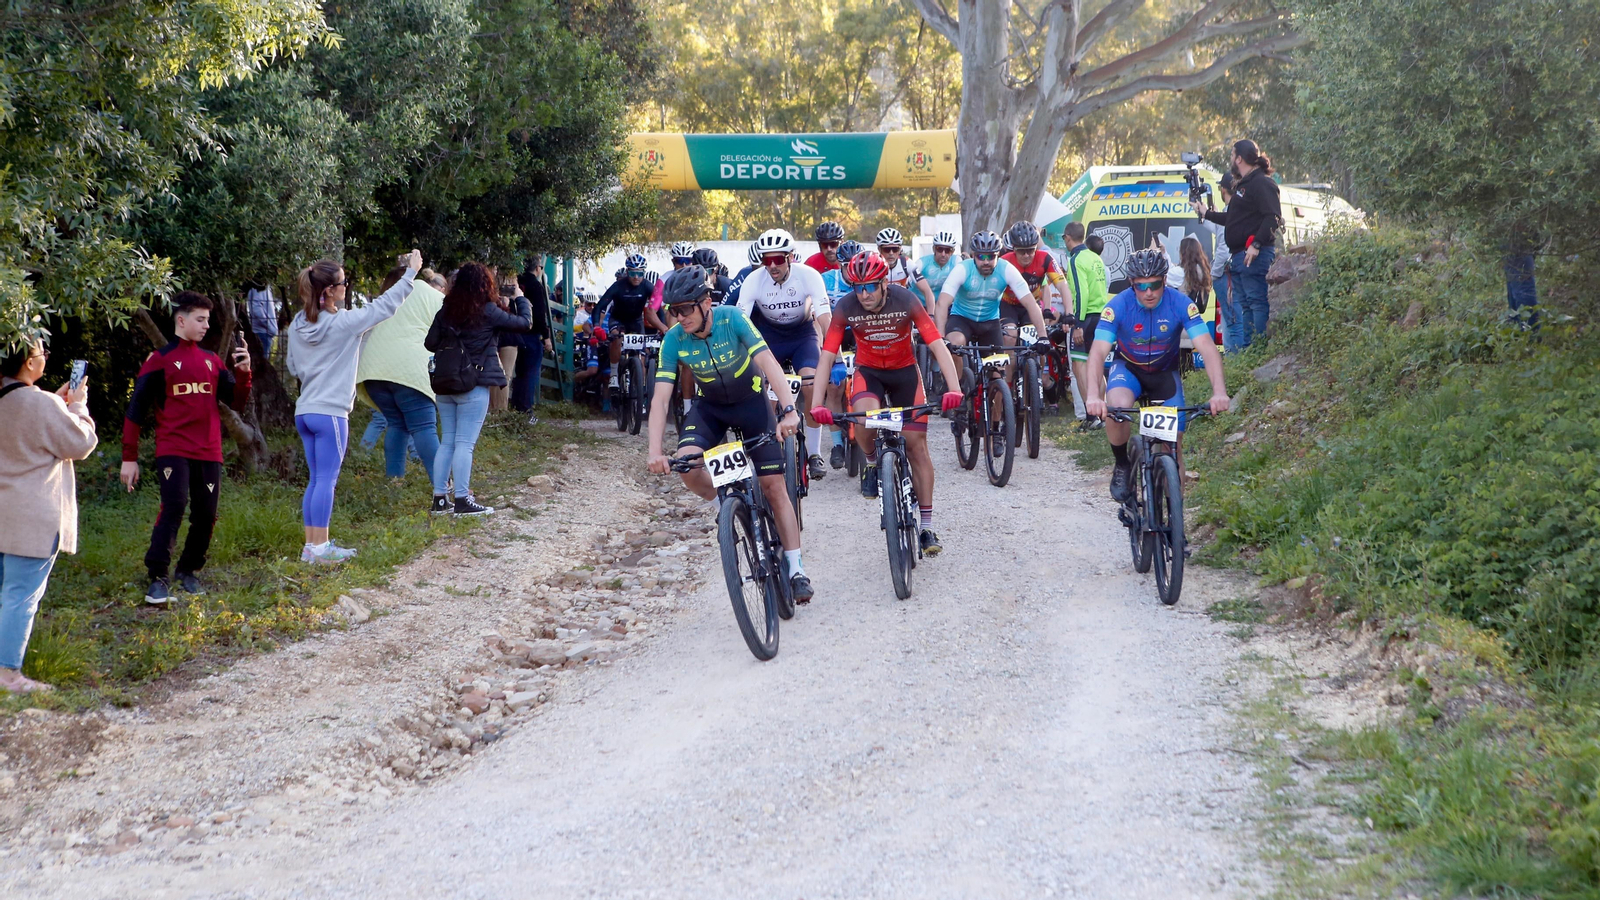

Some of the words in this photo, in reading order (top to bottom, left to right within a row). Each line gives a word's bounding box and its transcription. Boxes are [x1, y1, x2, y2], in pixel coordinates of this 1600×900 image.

[720, 154, 772, 162] DELEGACIÓN
[720, 163, 847, 180] DEPORTES
[626, 335, 643, 344] 184
[1143, 413, 1177, 431] 027
[709, 450, 748, 477] 249
